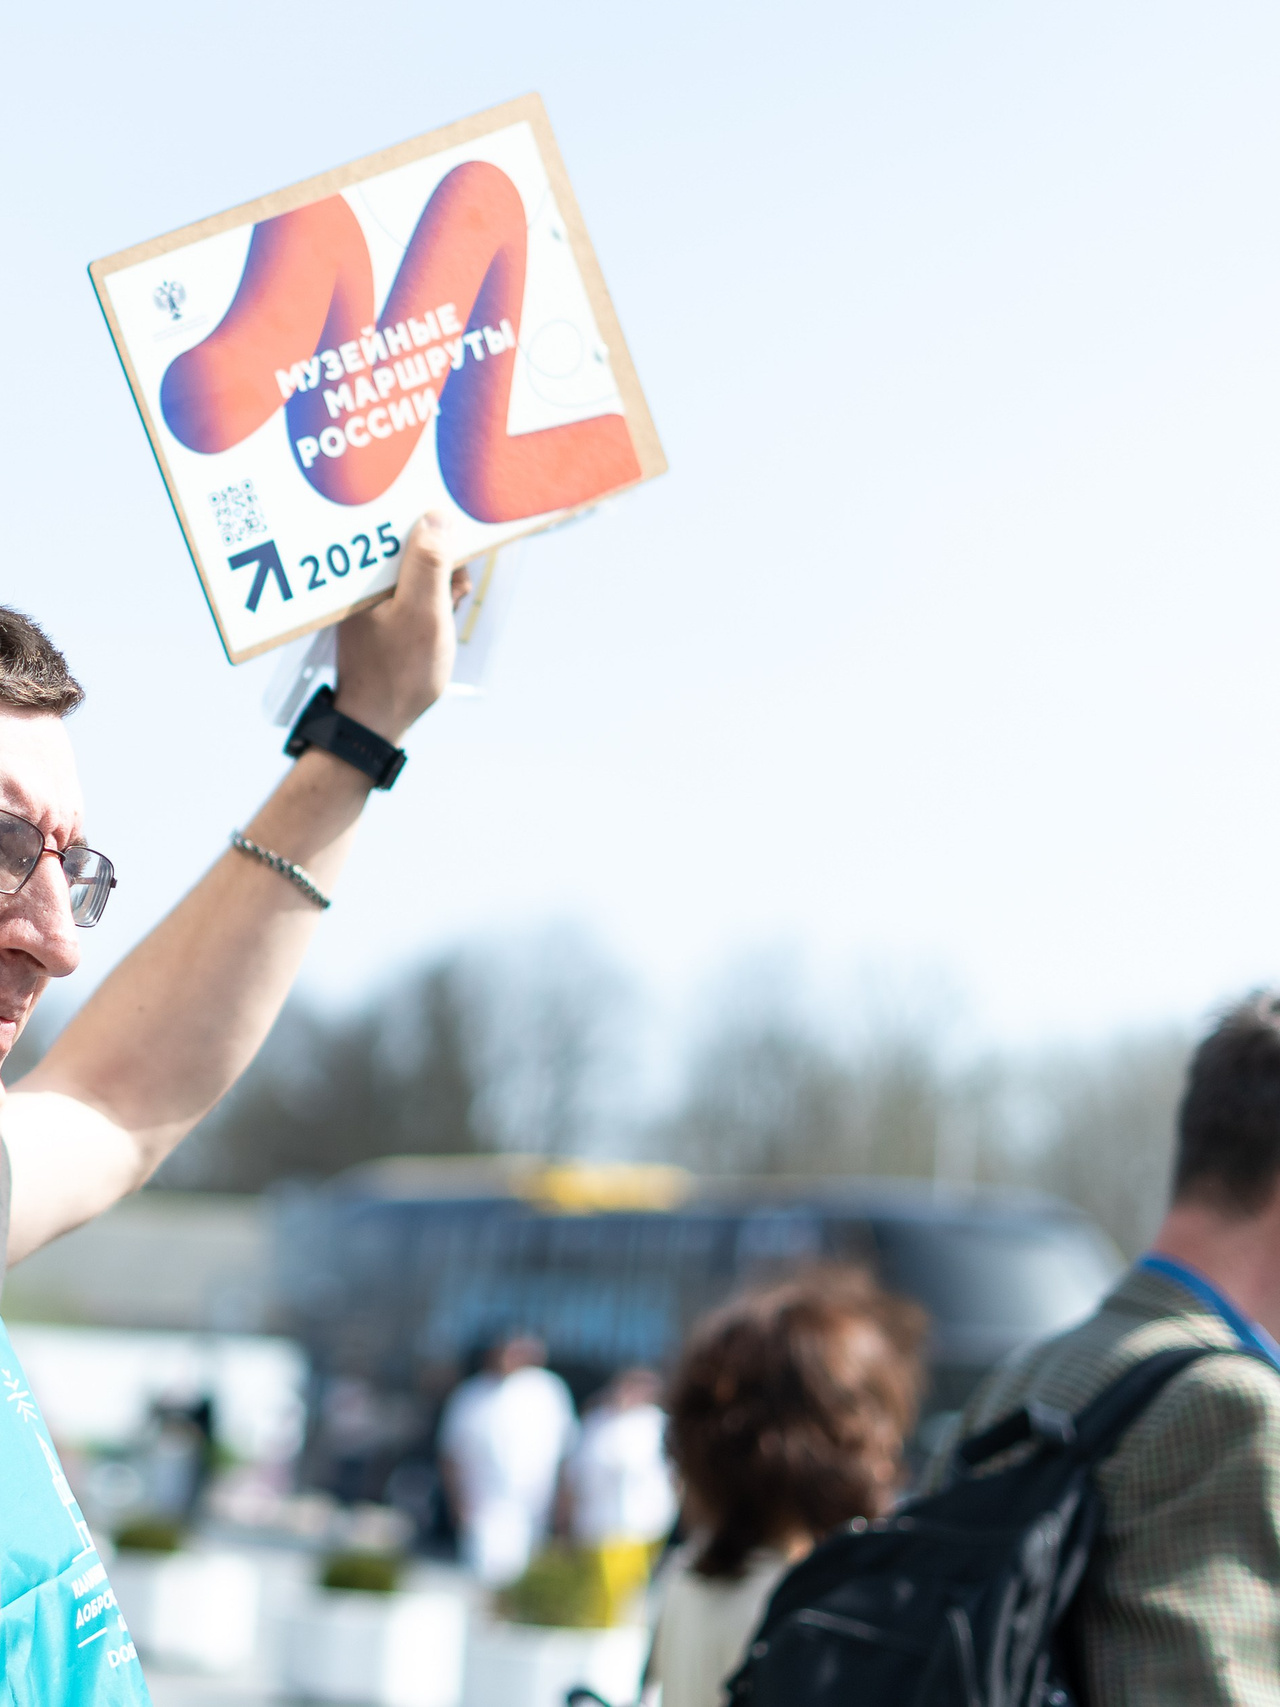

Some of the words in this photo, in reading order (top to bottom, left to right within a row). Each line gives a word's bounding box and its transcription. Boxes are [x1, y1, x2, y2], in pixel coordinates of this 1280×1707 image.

[274, 303, 463, 399] МУЗЕЙНЫЕ
[322, 318, 517, 419] МАРШРУТЫ
[296, 387, 442, 469] РОССИИ
[299, 522, 401, 591] 2025
